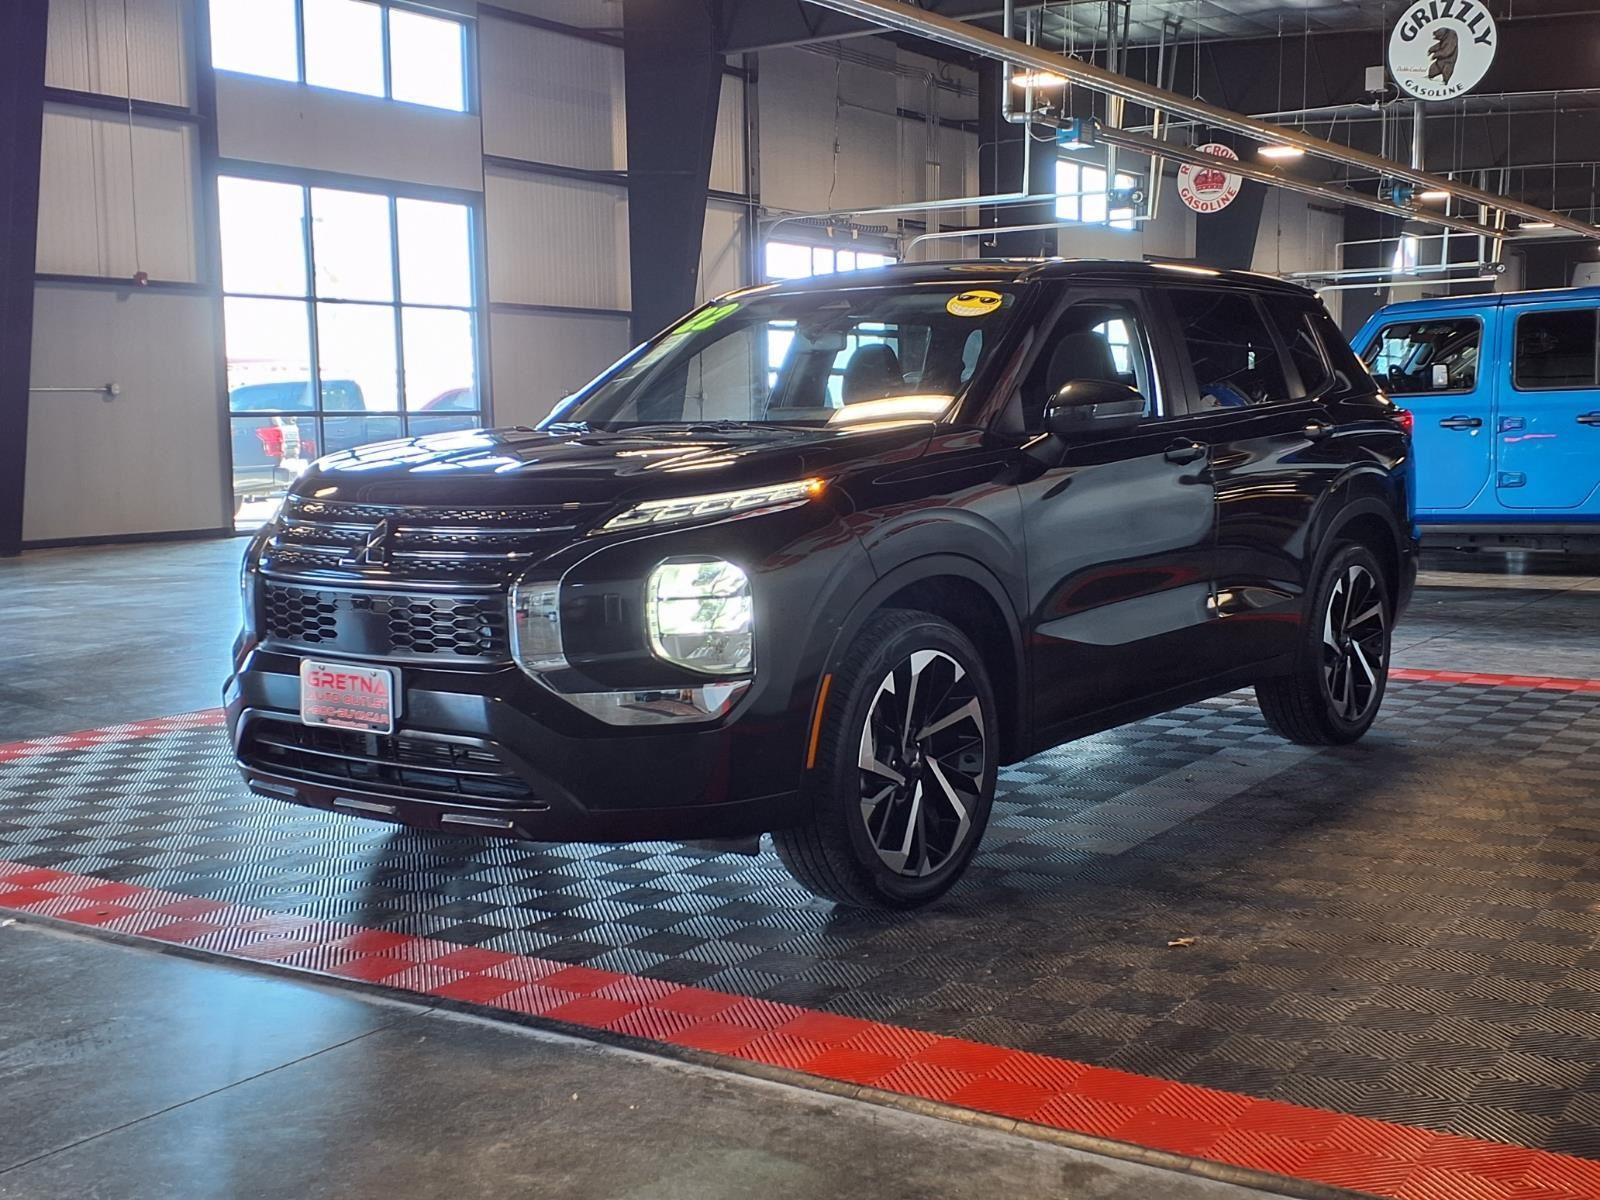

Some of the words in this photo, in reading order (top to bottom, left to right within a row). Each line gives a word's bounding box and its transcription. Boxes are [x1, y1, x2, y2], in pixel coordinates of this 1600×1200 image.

[1400, 0, 1492, 46] GRIZZLY
[1405, 79, 1465, 97] GASOLINE
[1203, 145, 1236, 160] CRO
[1181, 187, 1237, 211] GASOLINE
[308, 671, 386, 696] GRETNA
